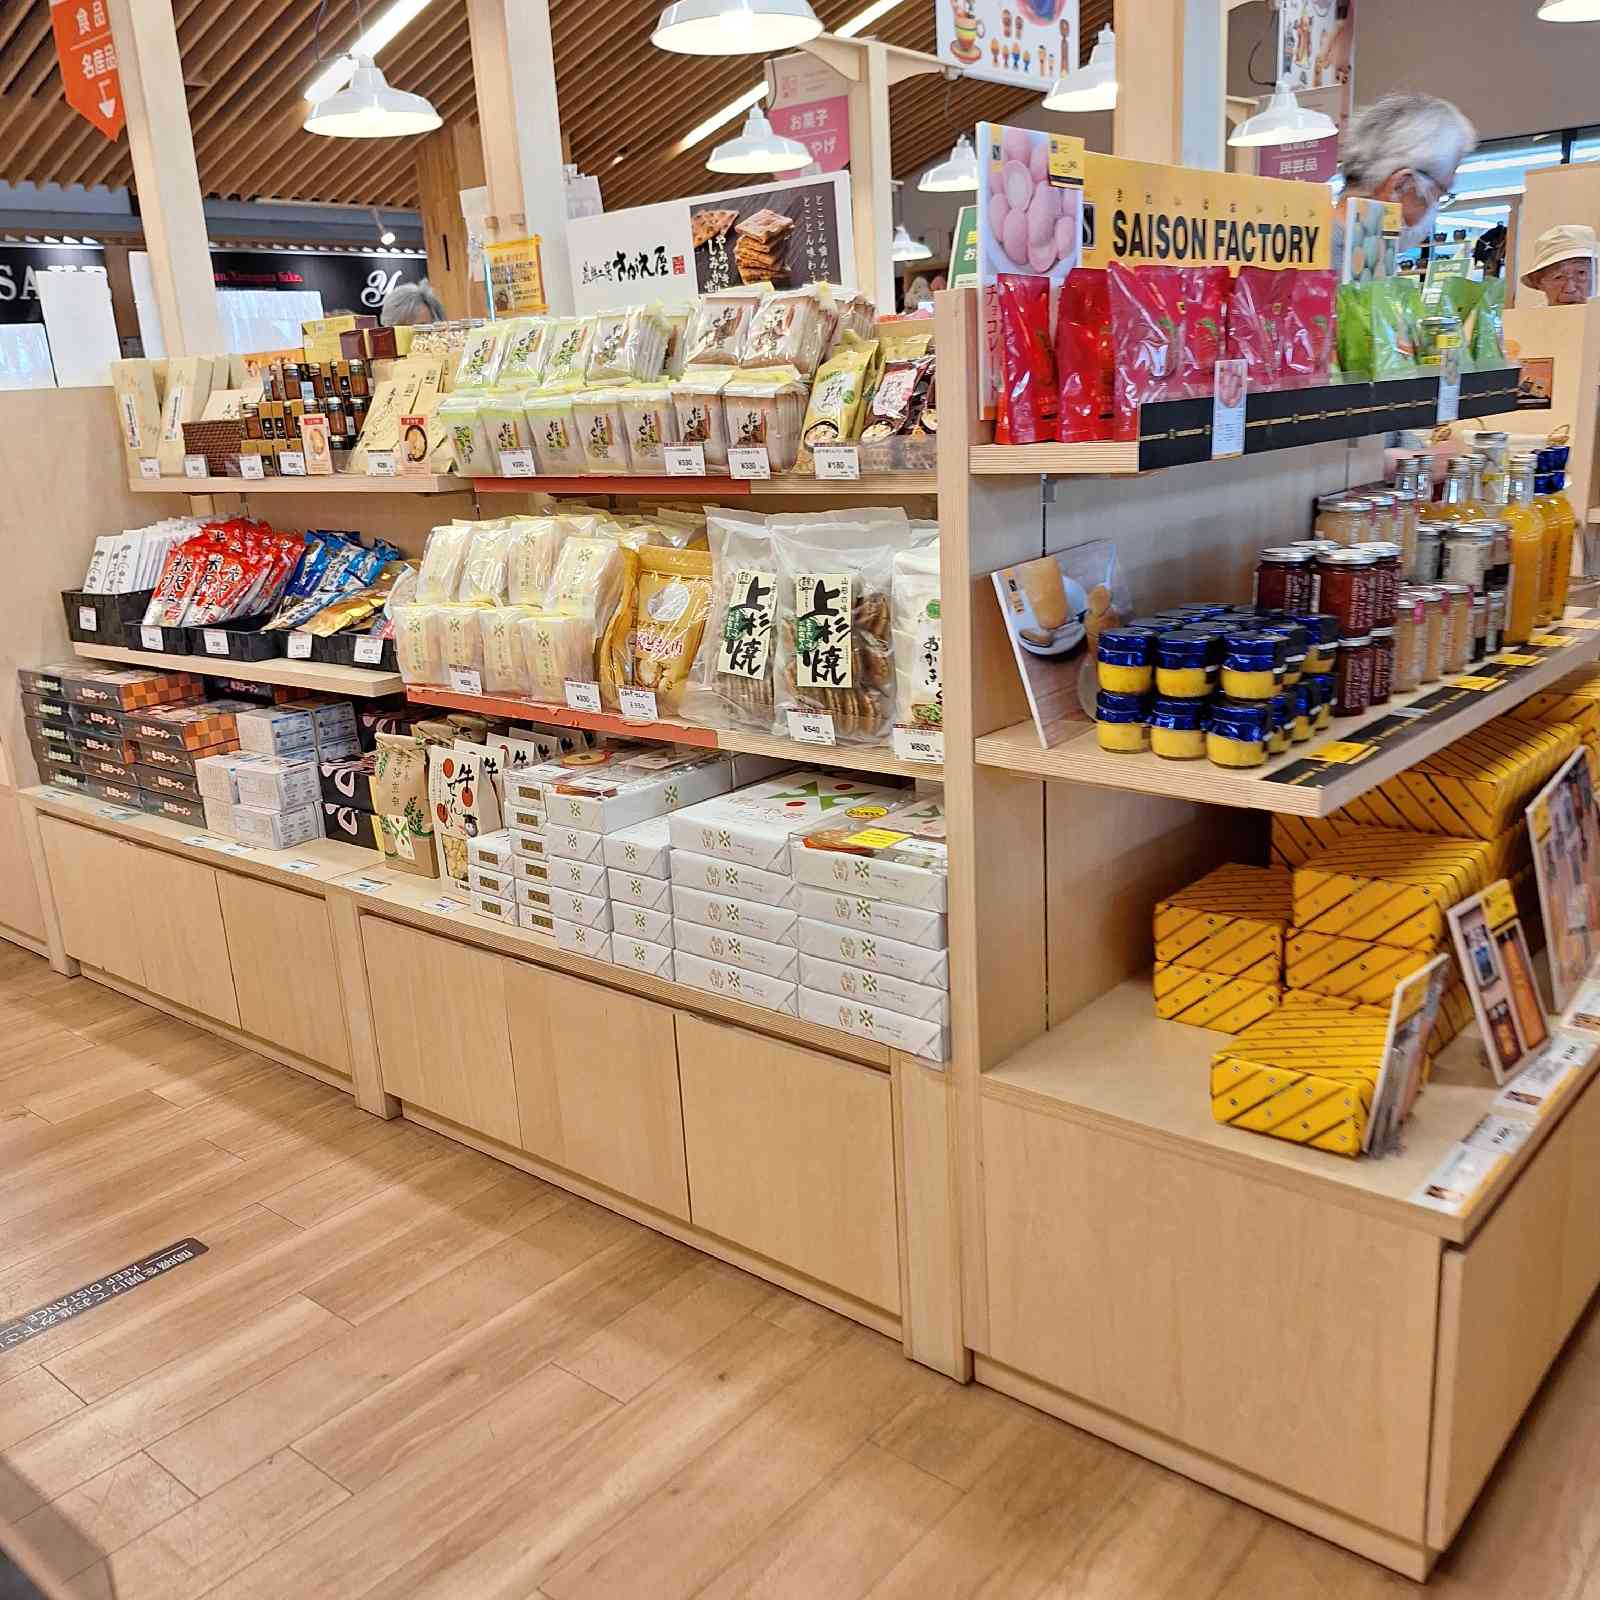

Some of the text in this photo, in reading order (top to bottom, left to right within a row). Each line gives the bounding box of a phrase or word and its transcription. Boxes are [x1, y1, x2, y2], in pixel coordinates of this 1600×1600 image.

[1112, 209, 1320, 264] SAISON FACTORY
[799, 579, 852, 686] 上杉焼
[28, 1265, 143, 1323] KEEP DISTANCE
